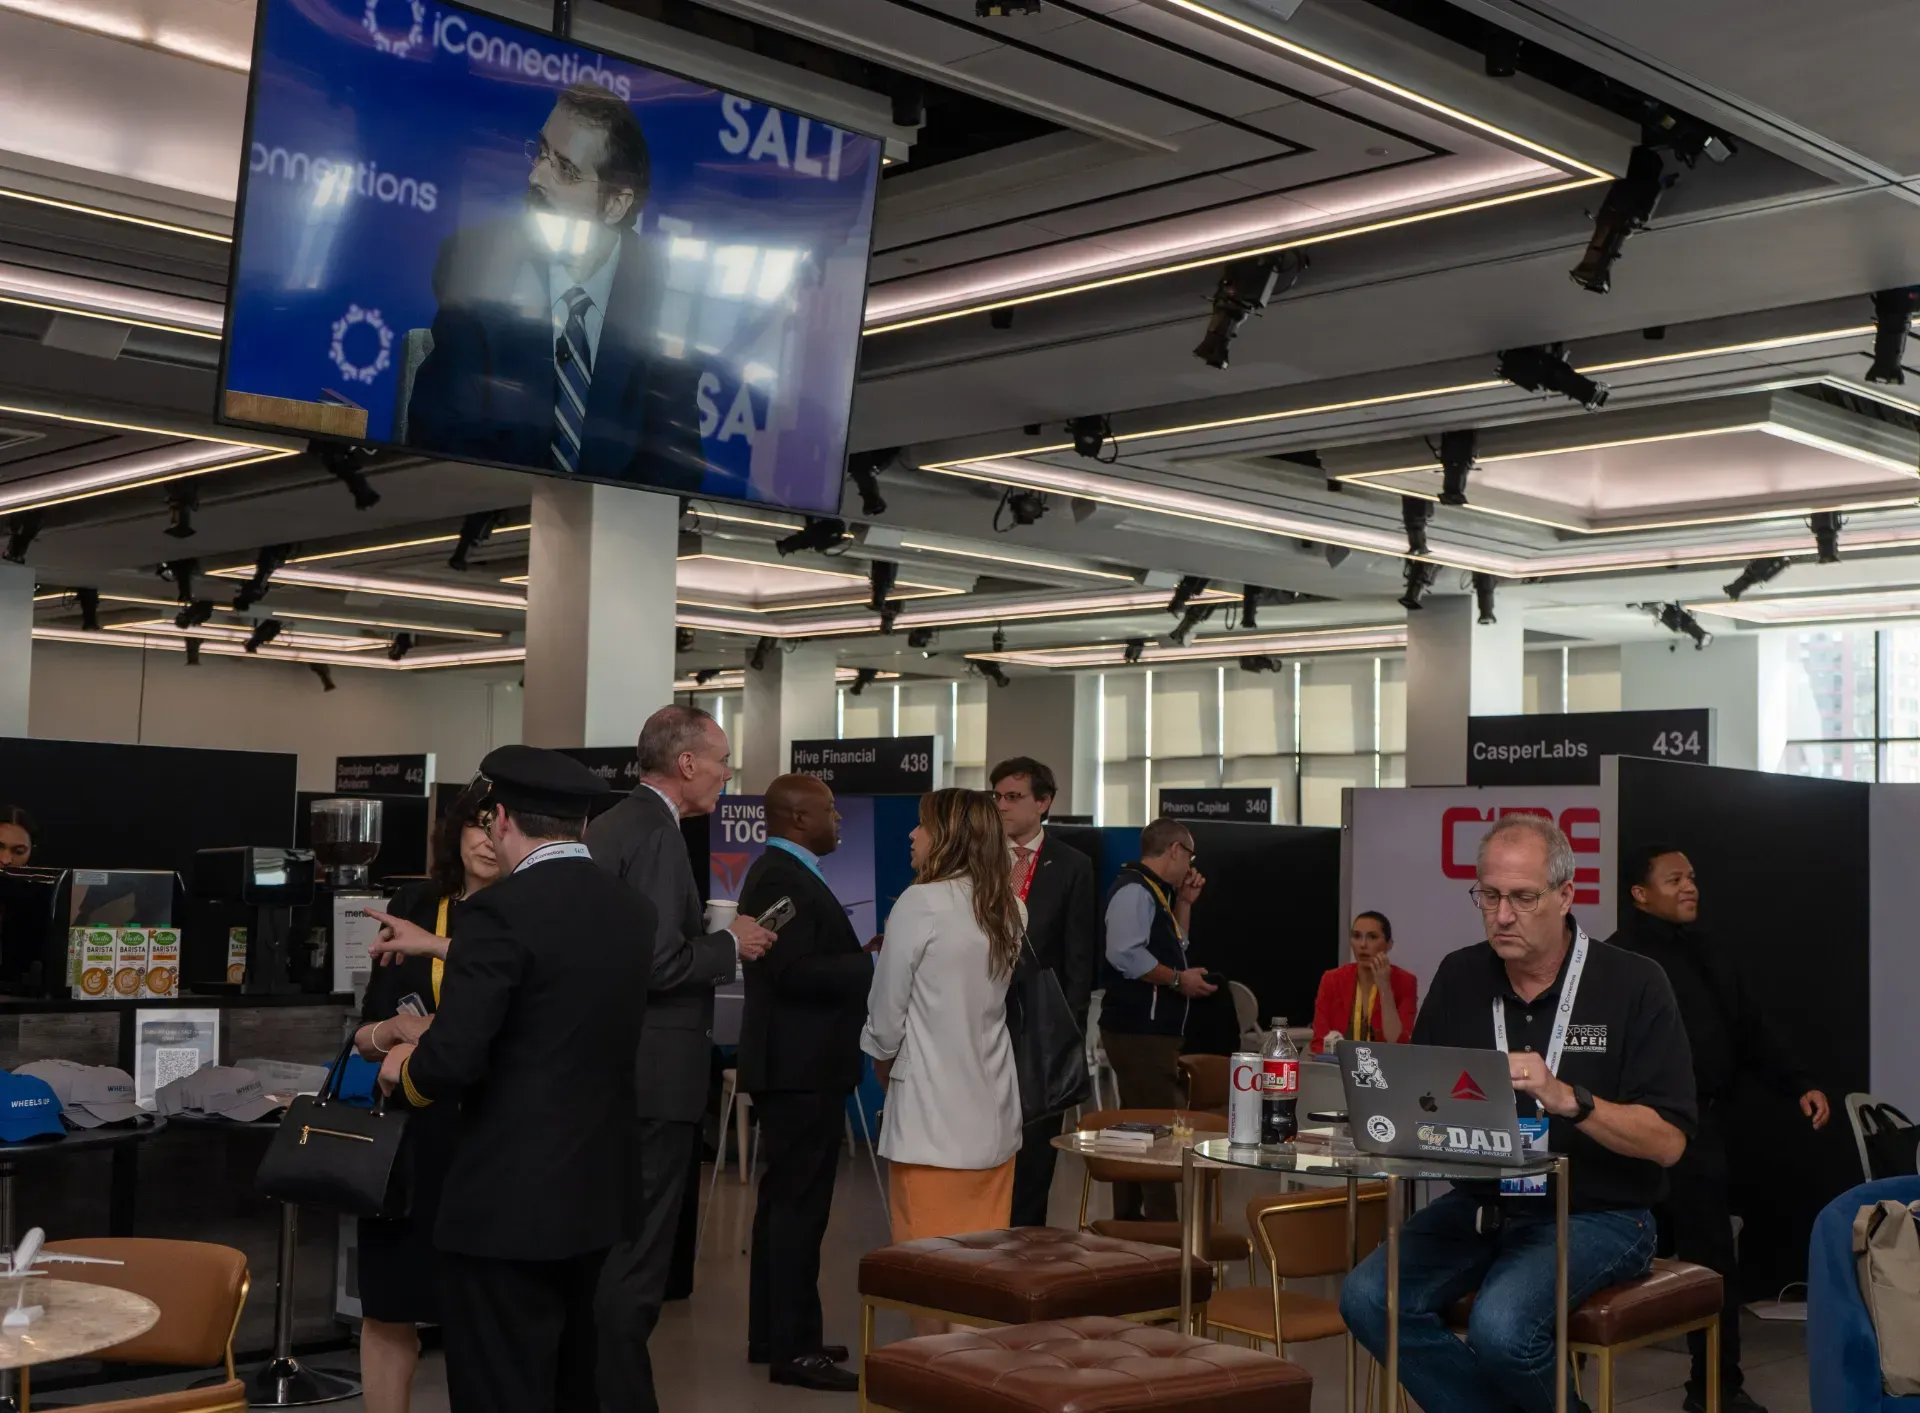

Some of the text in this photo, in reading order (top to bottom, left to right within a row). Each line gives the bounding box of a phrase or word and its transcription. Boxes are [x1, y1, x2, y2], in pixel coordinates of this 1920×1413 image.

[433, 12, 631, 101] iConnections
[718, 93, 854, 181] SALT
[1472, 740, 1588, 764] CasperLabs
[1652, 731, 1701, 756] 434
[794, 748, 876, 765] Hive Financial
[900, 753, 928, 773] 438
[624, 761, 640, 778] 44
[721, 805, 765, 819] FLYING
[1163, 801, 1230, 815] Pharos Capital
[1246, 800, 1268, 813] 340
[1575, 949, 1584, 964] SALT
[1565, 974, 1577, 1004] iConnections
[1556, 1024, 1564, 1040] SALT
[1566, 1027, 1608, 1036] XPRESS
[11, 1099, 42, 1108] WHEELS
[1446, 1127, 1513, 1153] DAD
[1445, 1147, 1480, 1155] WASHINGTON
